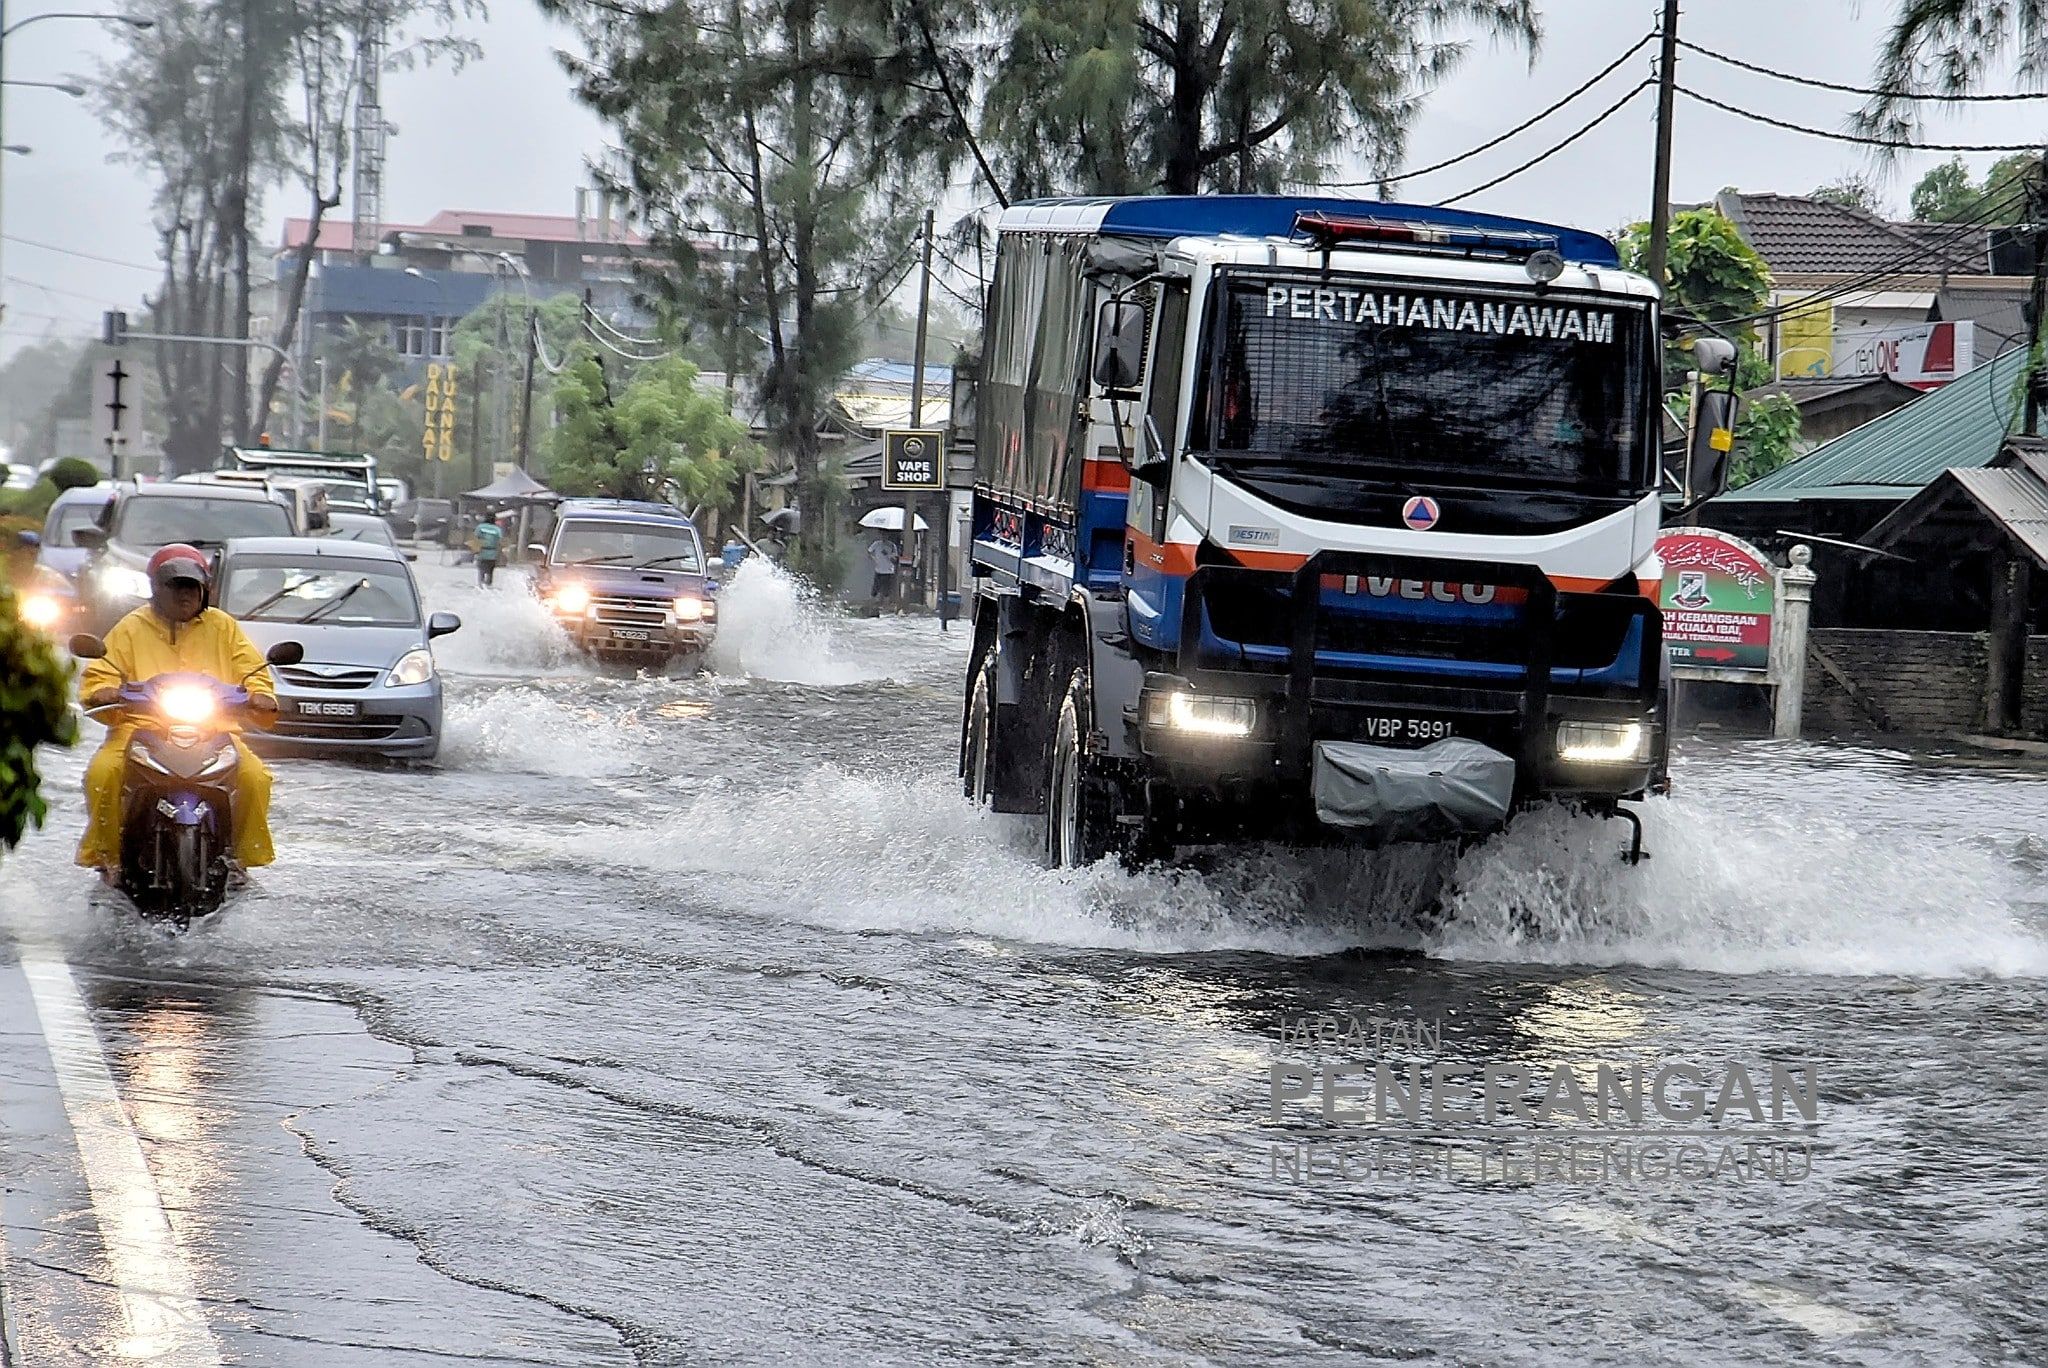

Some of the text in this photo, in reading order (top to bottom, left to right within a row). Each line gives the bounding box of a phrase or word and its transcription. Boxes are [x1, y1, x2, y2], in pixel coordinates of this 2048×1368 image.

[1266, 286, 1615, 344] PERTAHANANAWAM
[1855, 341, 1899, 373] redONE
[422, 364, 441, 461] DAULAT
[438, 363, 458, 461] TUANKU
[897, 461, 930, 471] VAPE
[897, 472, 931, 482] SHOP
[1344, 574, 1495, 604] IVECO
[1676, 622, 1715, 634] KUALA
[1678, 612, 1758, 626] KEBANGSAAN
[1366, 717, 1452, 738] VBP 5991
